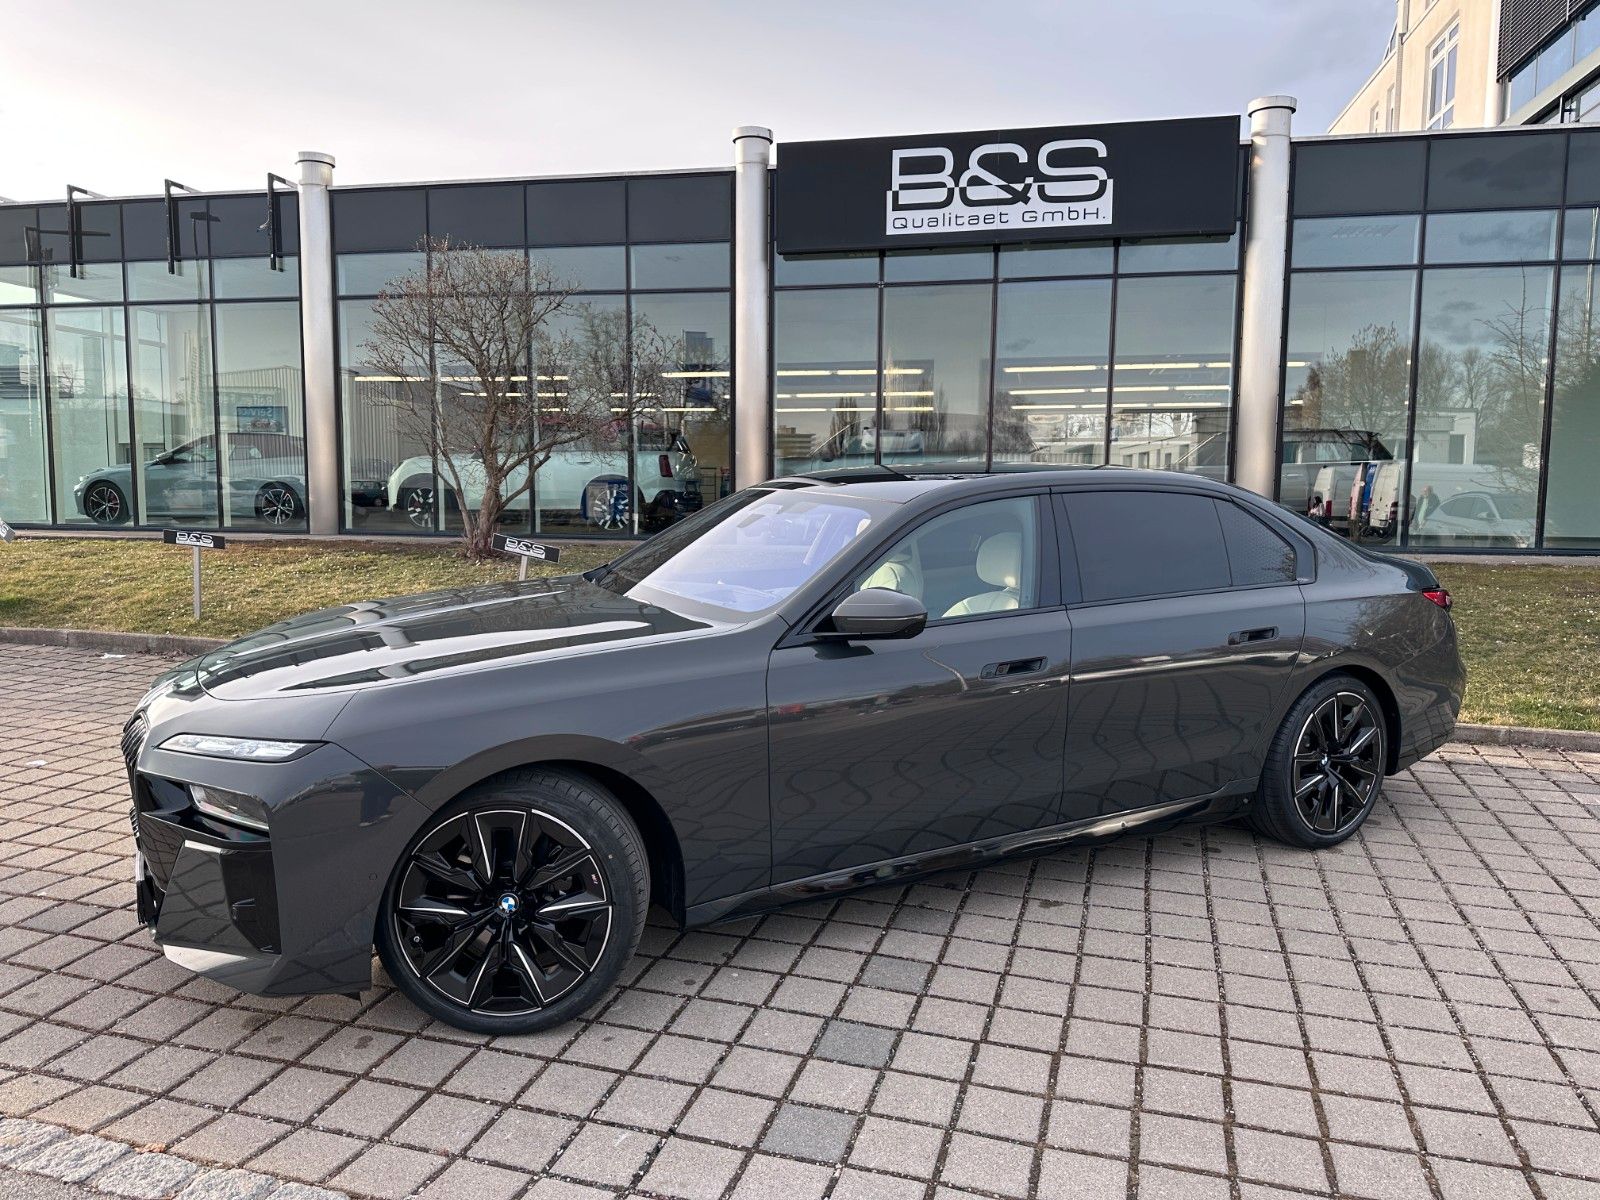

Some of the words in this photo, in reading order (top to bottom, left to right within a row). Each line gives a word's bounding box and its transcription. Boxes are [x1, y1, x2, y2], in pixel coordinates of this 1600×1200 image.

[892, 138, 1108, 212] B&S
[892, 211, 1010, 230] Qualitaet
[1021, 206, 1107, 222] GmbH.
[176, 532, 213, 545] B&S
[505, 538, 545, 555] B&S
